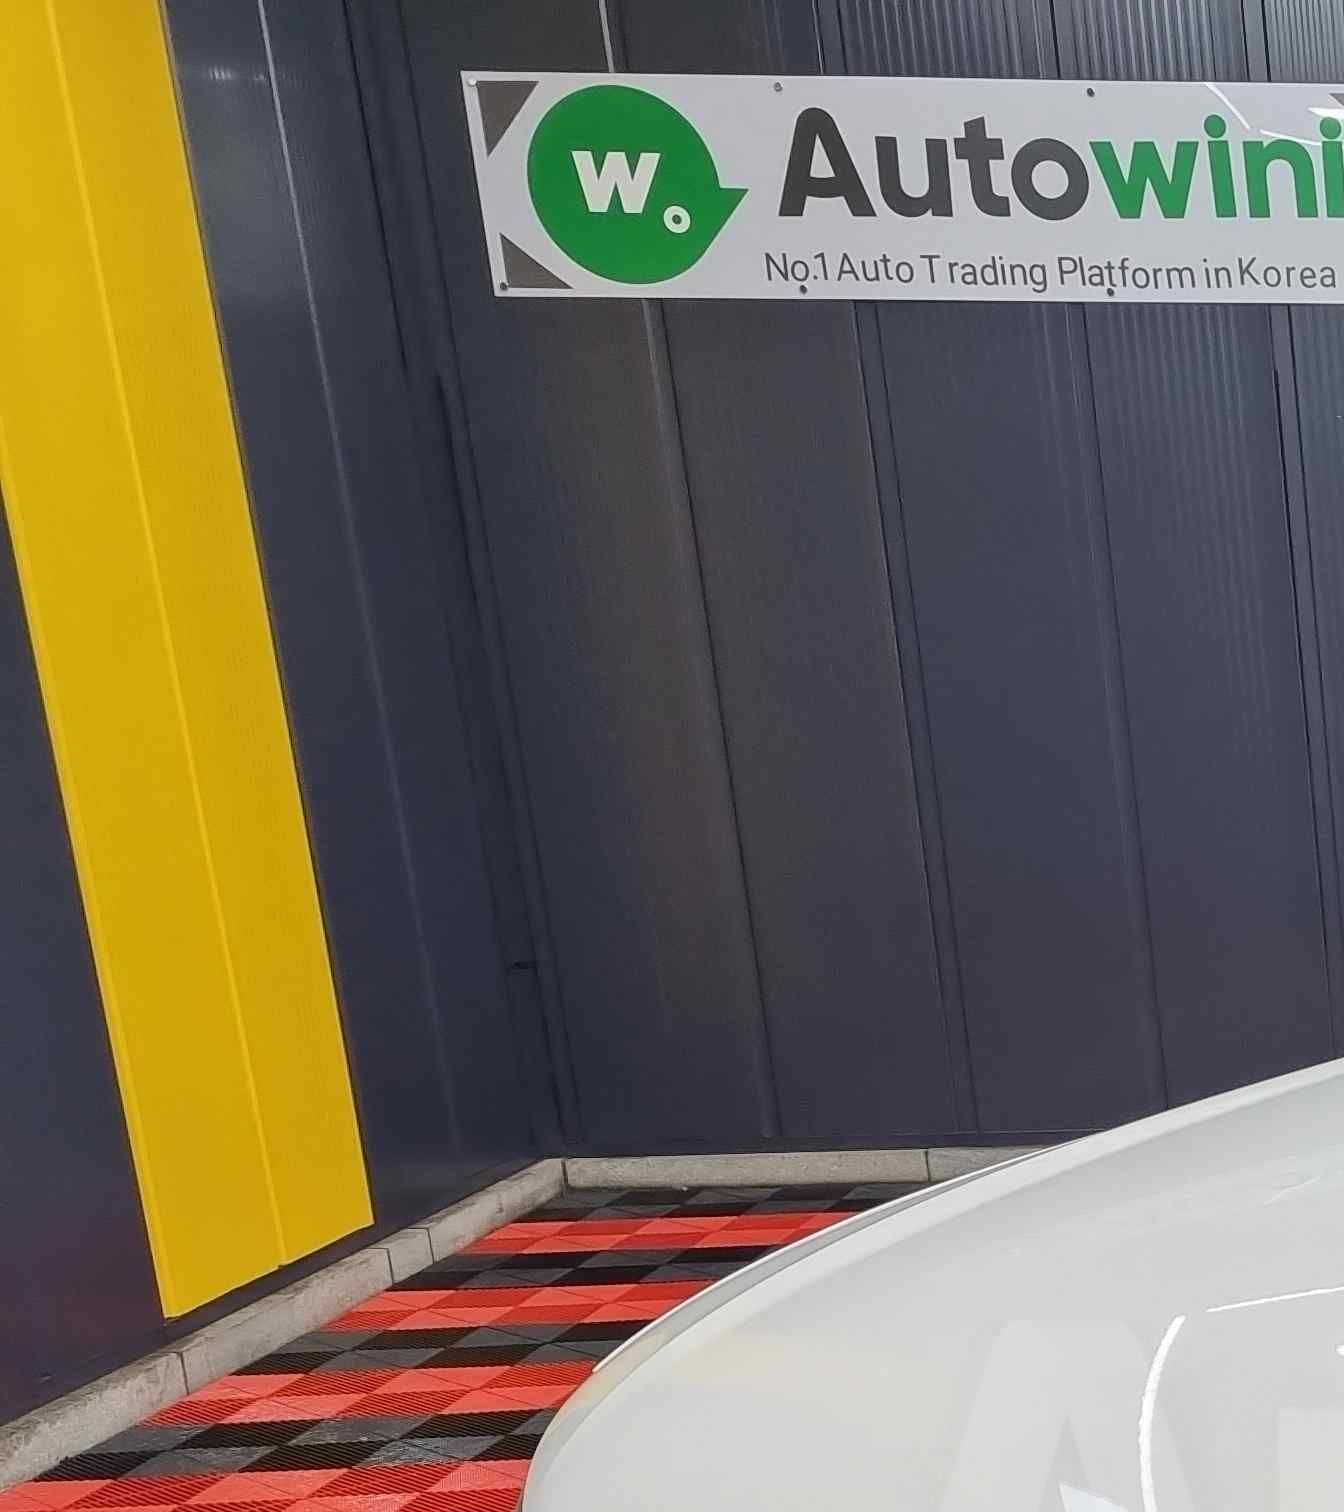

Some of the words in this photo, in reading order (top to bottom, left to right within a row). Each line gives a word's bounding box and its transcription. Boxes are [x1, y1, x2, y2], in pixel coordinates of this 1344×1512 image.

[837, 252, 914, 284] Auto
[919, 254, 1048, 293] Trading
[1057, 256, 1196, 290] Platform
[1203, 256, 1233, 290] in
[1238, 257, 1336, 290] Korea
